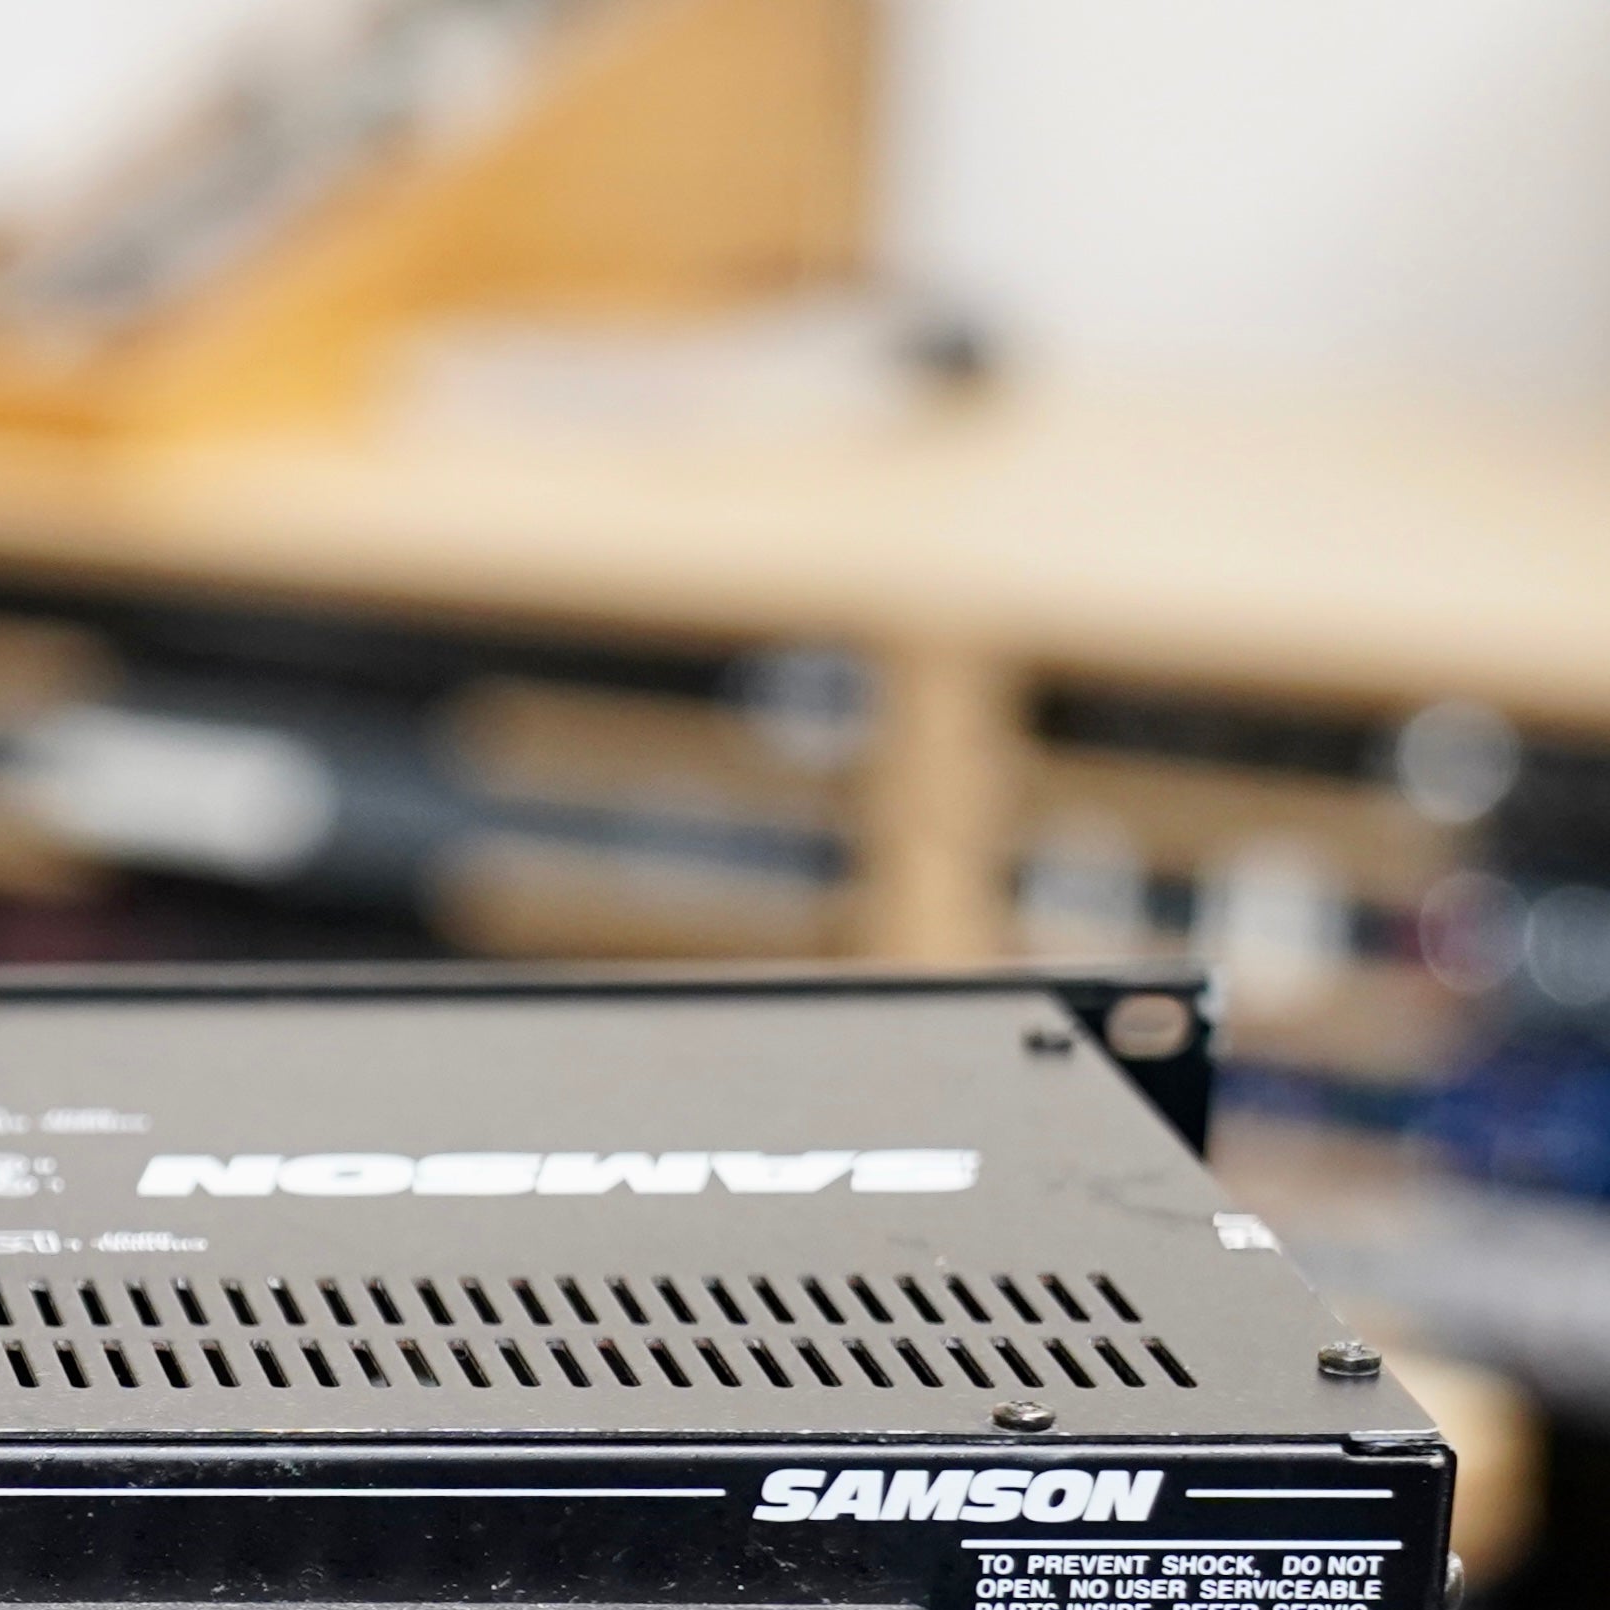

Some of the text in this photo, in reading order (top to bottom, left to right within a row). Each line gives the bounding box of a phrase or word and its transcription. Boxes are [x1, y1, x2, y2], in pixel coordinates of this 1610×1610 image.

[137, 1149, 979, 1196] SAMSON
[753, 1469, 1164, 1523] SAMSON
[978, 1554, 1384, 1581] TO PREVENT SHOCK, DO NOT
[976, 1577, 1382, 1600] OPEN. NO USER SERVICEABLE
